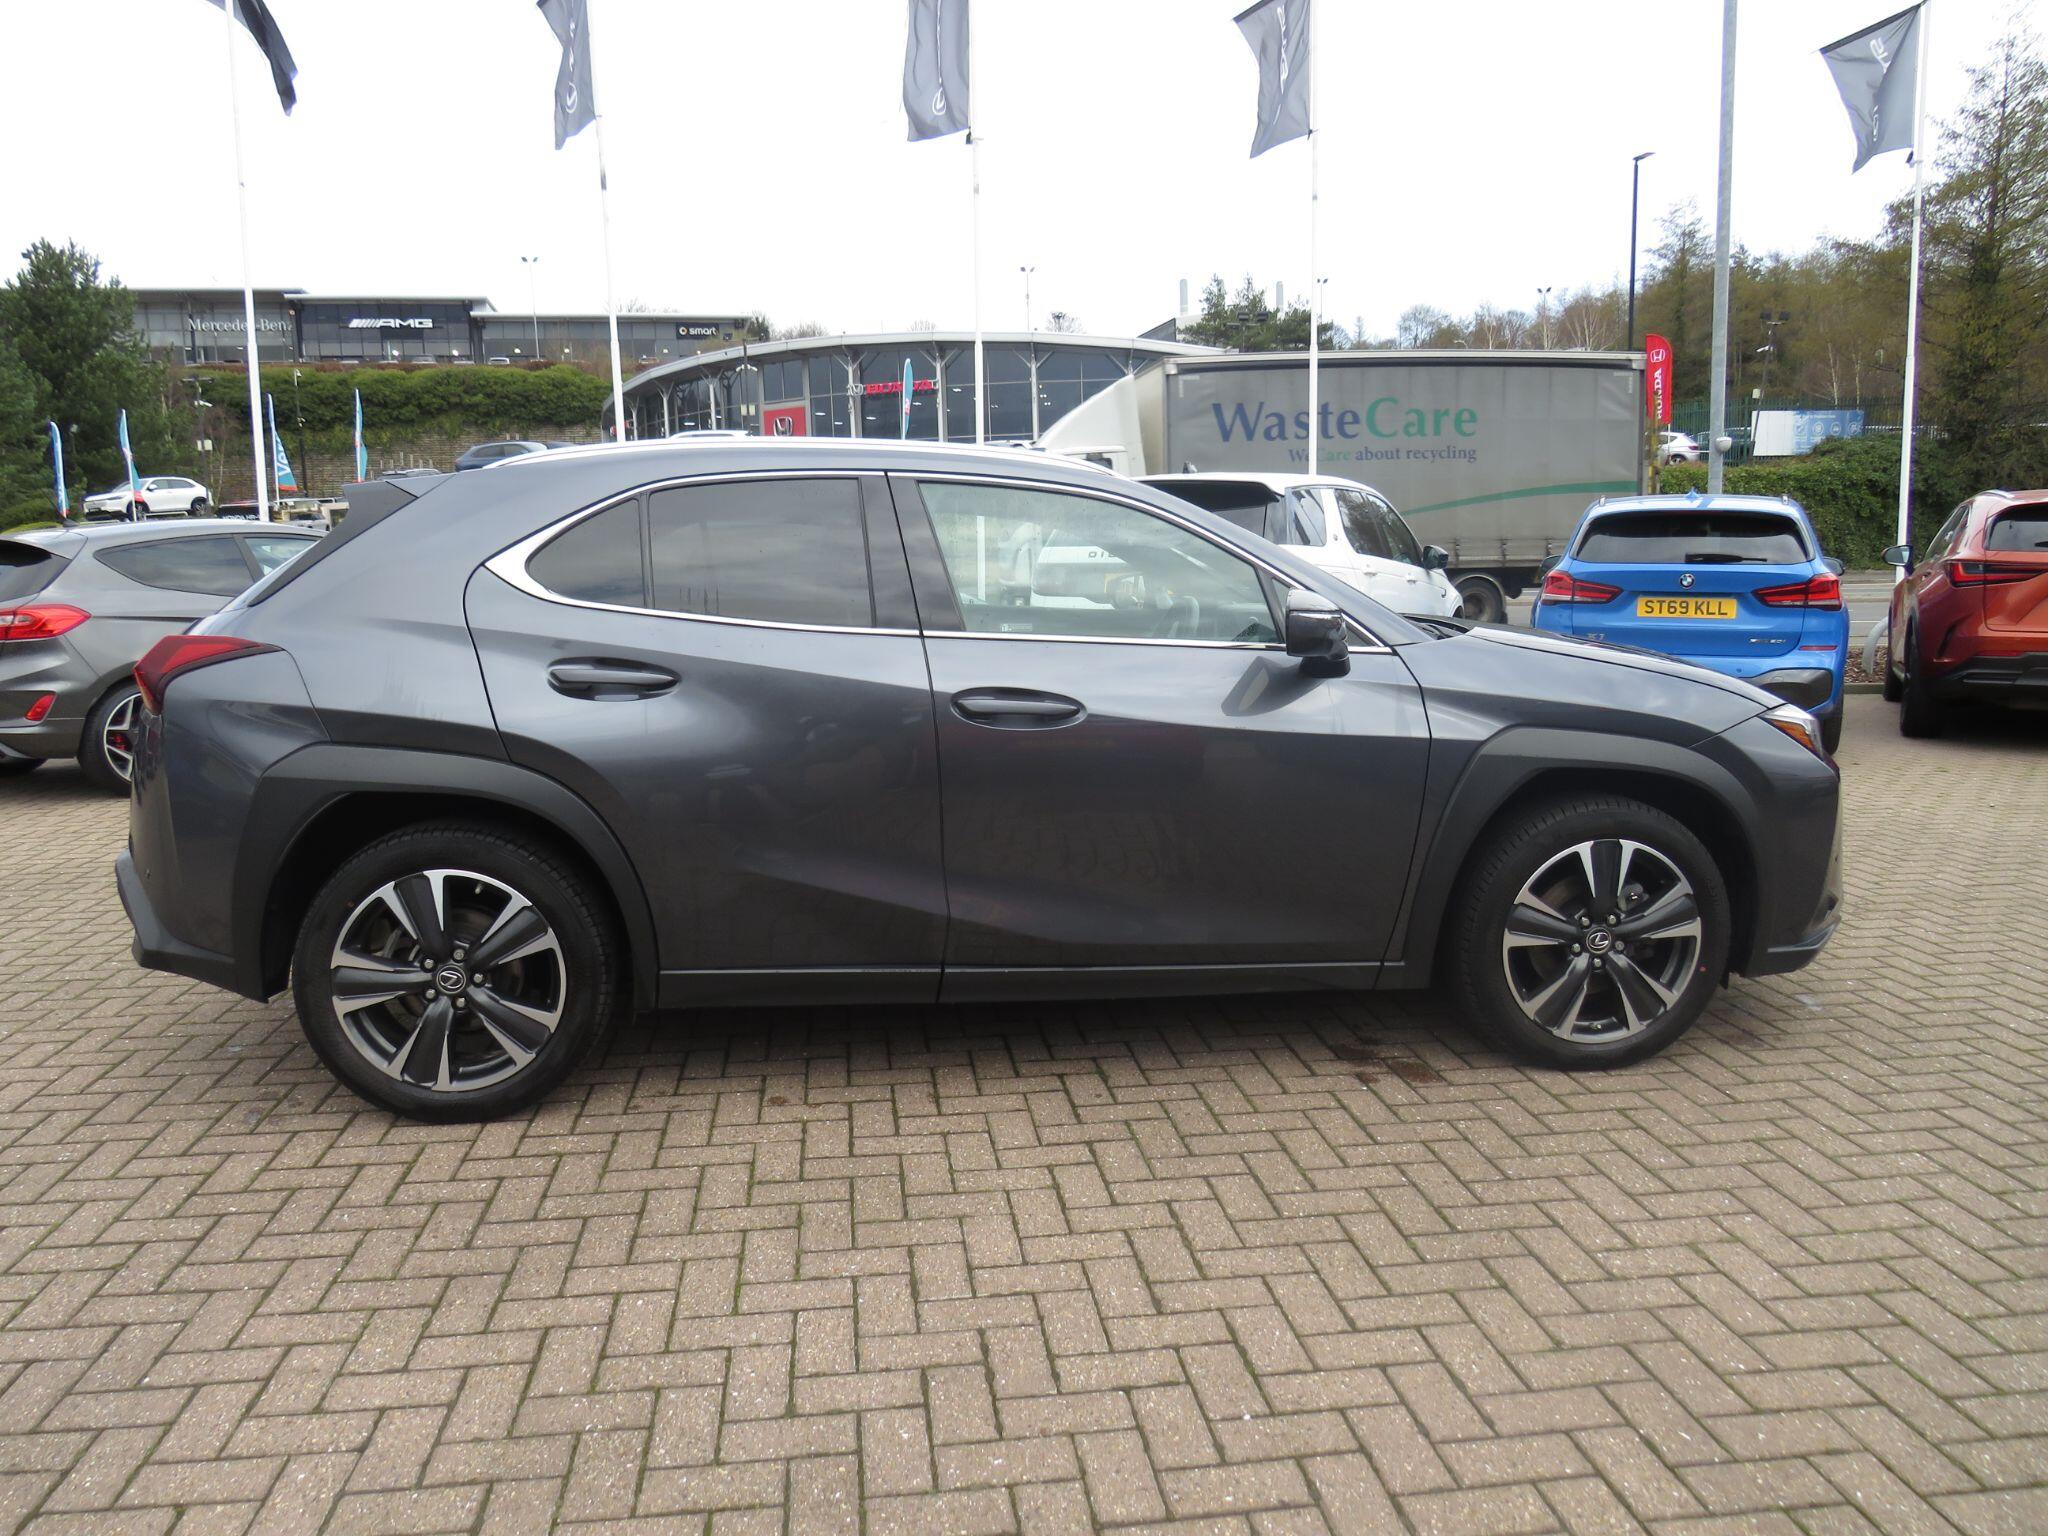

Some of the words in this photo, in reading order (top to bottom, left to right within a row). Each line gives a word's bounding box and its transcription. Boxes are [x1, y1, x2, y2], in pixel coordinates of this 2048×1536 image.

[188, 318, 292, 332] Mercede-Benz
[379, 318, 434, 329] AMG
[689, 326, 717, 336] smart
[1211, 396, 1479, 443] WasteCare
[1355, 446, 1401, 461] about
[1406, 444, 1477, 464] recycling
[1644, 600, 1690, 616] ST69
[1693, 601, 1728, 616] KLL
